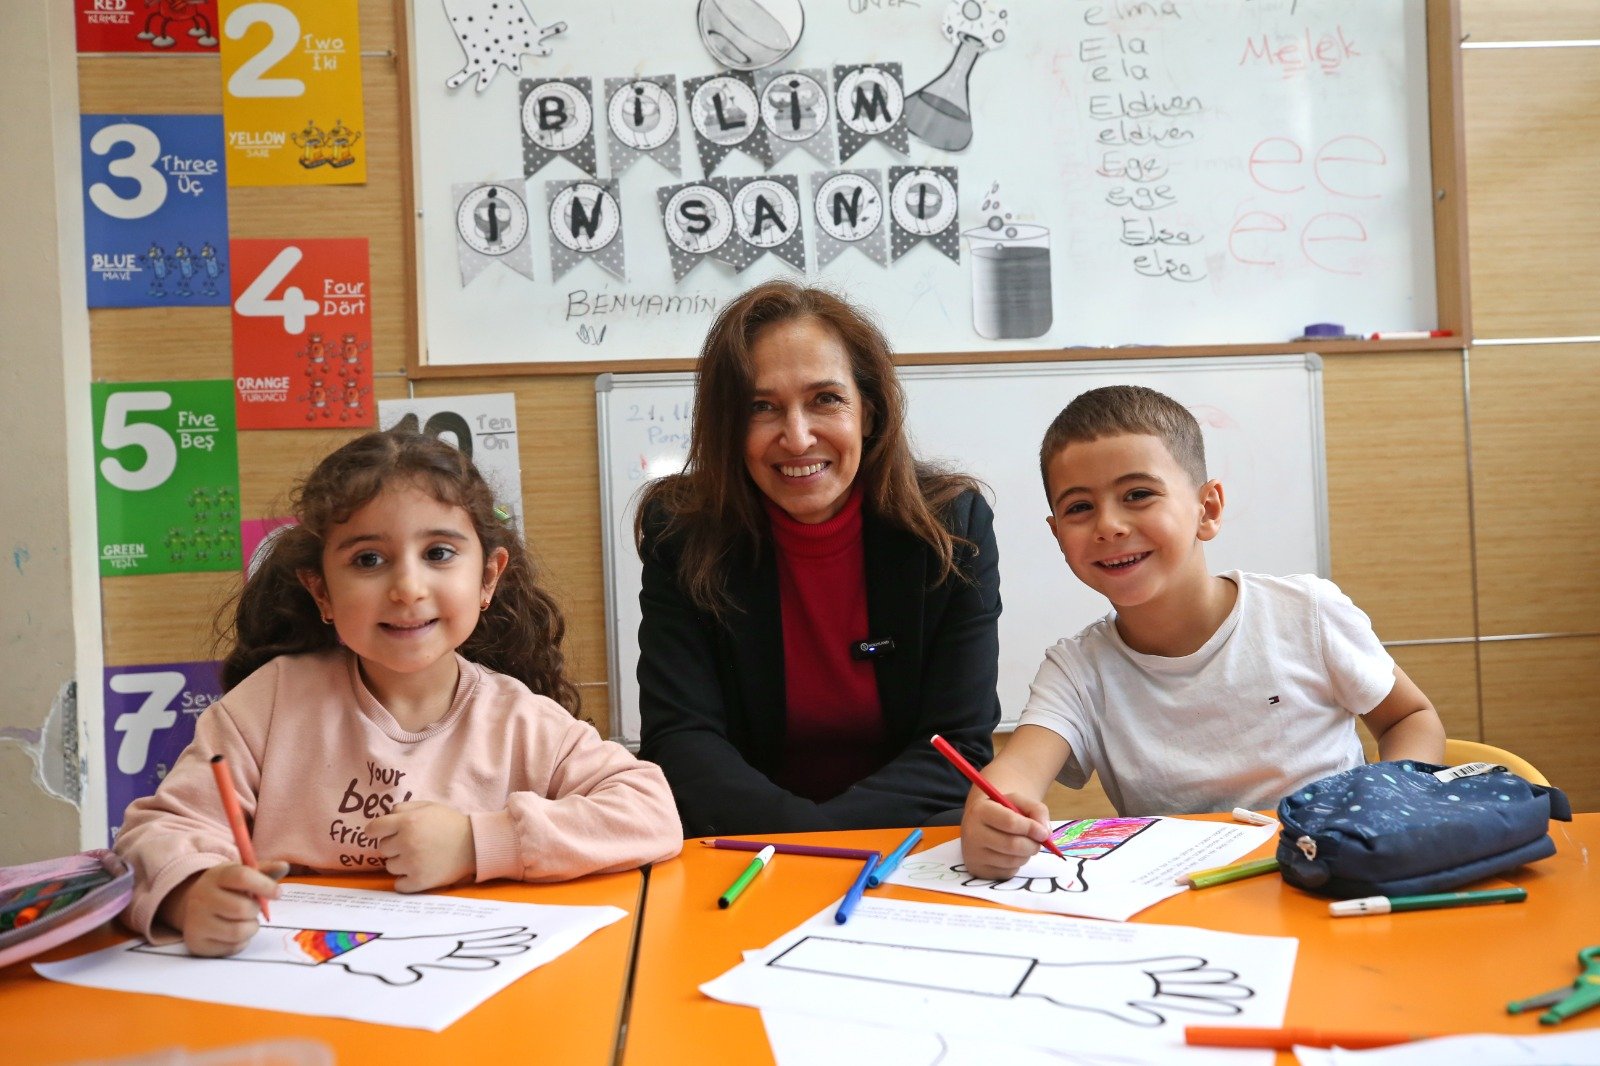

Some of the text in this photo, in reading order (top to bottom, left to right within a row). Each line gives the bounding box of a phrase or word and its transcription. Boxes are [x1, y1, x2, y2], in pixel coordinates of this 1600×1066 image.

[94, 0, 127, 10] RED
[224, 3, 306, 98] 2
[303, 33, 344, 50] Two
[1079, 34, 1150, 62] Ela
[1240, 25, 1361, 66] Melek
[1091, 59, 1150, 82] ela
[538, 79, 892, 131] BİLİM
[228, 131, 286, 145] YELLOW
[88, 123, 168, 220] 3
[161, 154, 218, 172] Three
[178, 174, 204, 197] Üç
[1121, 216, 1191, 242] Elsa
[92, 254, 136, 268] BLUE
[1133, 249, 1193, 277] elsa
[234, 246, 320, 335] 4
[324, 279, 364, 294] Four
[323, 299, 365, 316] Dört
[237, 377, 290, 390] ORANGE
[178, 411, 216, 427] Five
[476, 414, 512, 430] Ten
[100, 391, 178, 492] 5
[181, 432, 216, 452] Beş
[484, 434, 510, 450] On
[103, 544, 145, 556] GREEN
[181, 691, 222, 708] Sev
[109, 671, 187, 775] 7
[366, 761, 406, 787] Your
[338, 778, 413, 818] bes
[329, 820, 379, 850] frien
